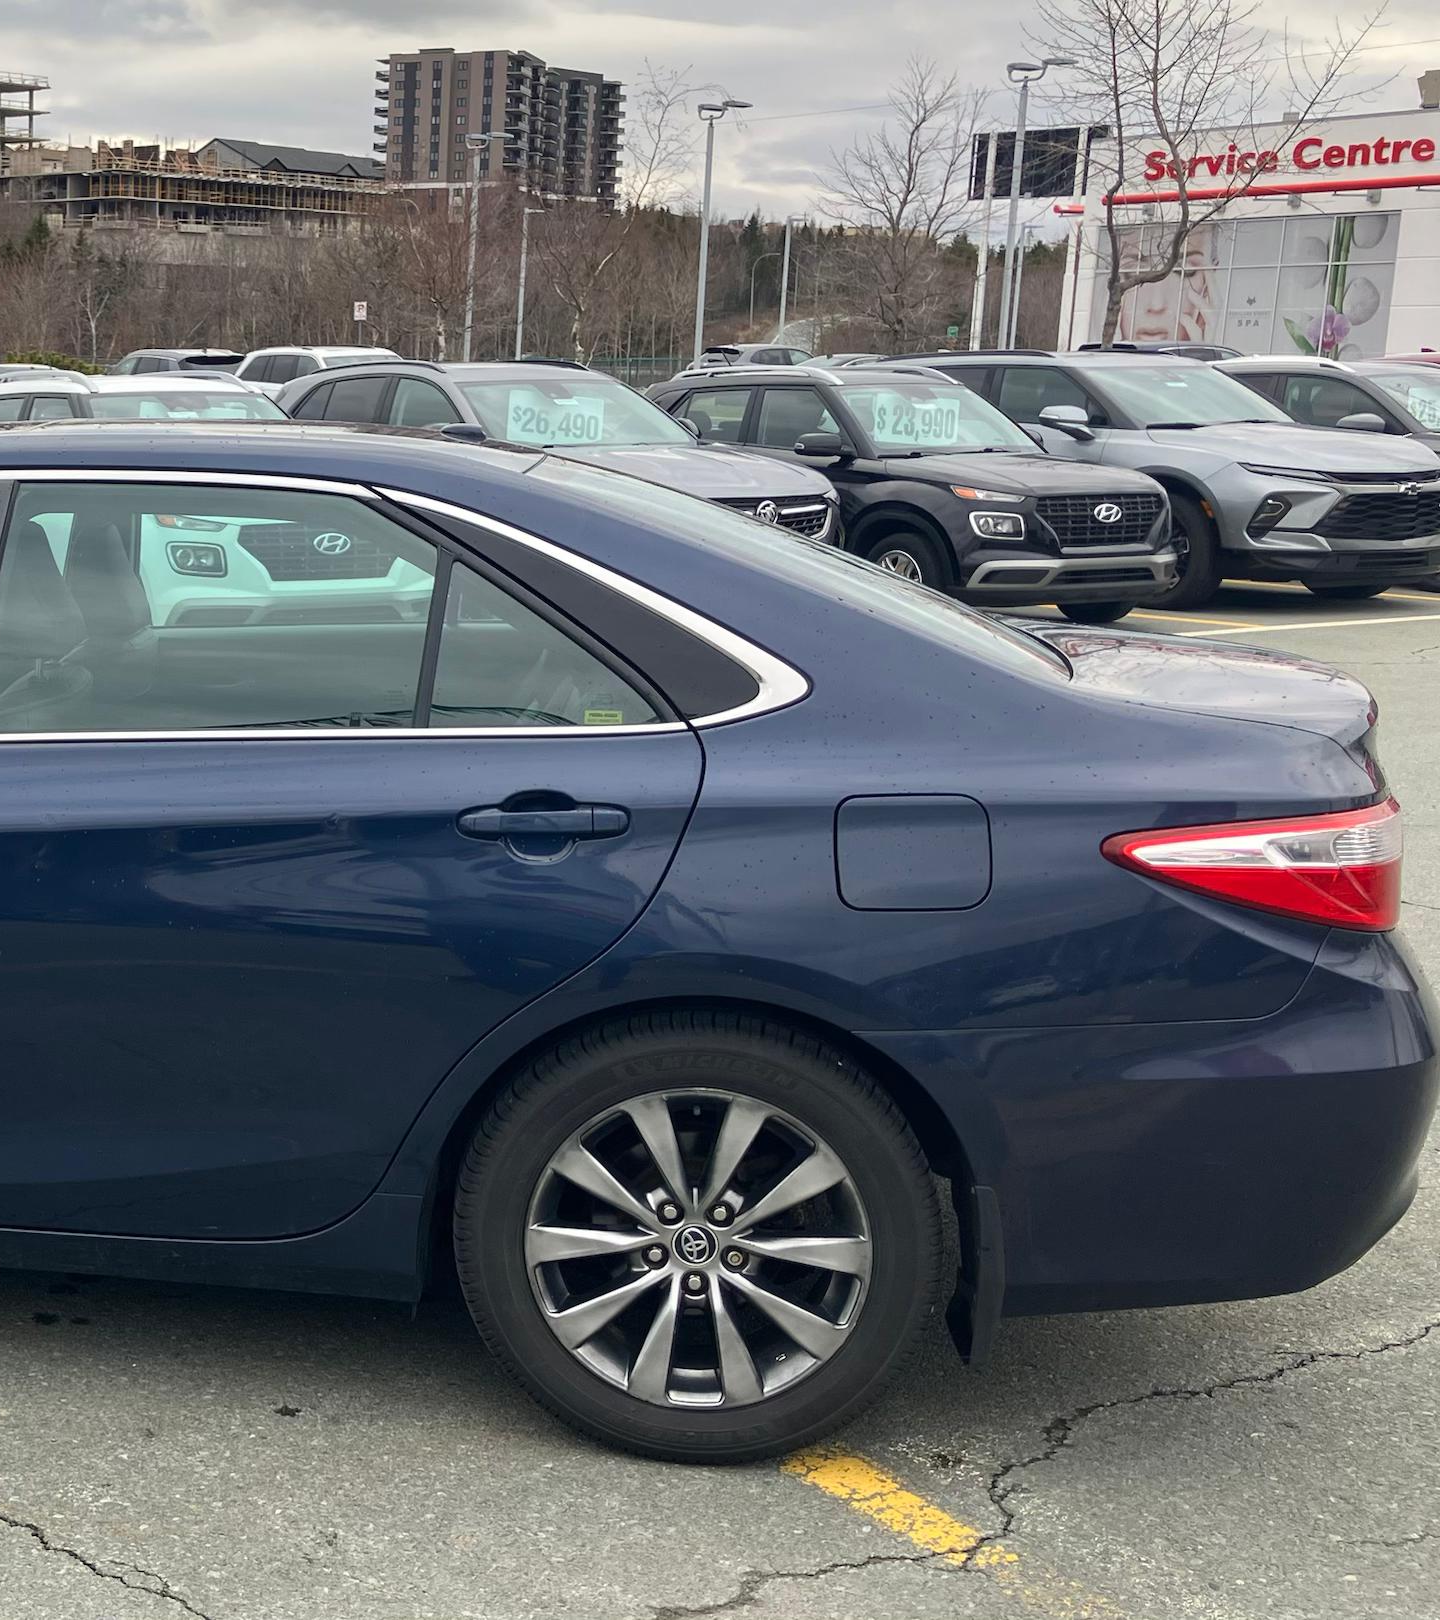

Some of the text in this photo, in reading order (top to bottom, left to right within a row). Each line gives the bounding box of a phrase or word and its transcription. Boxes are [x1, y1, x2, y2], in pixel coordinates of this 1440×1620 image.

[1143, 136, 1436, 182] Service Centre
[1237, 319, 1259, 327] SPA
[512, 406, 600, 440] $26,490
